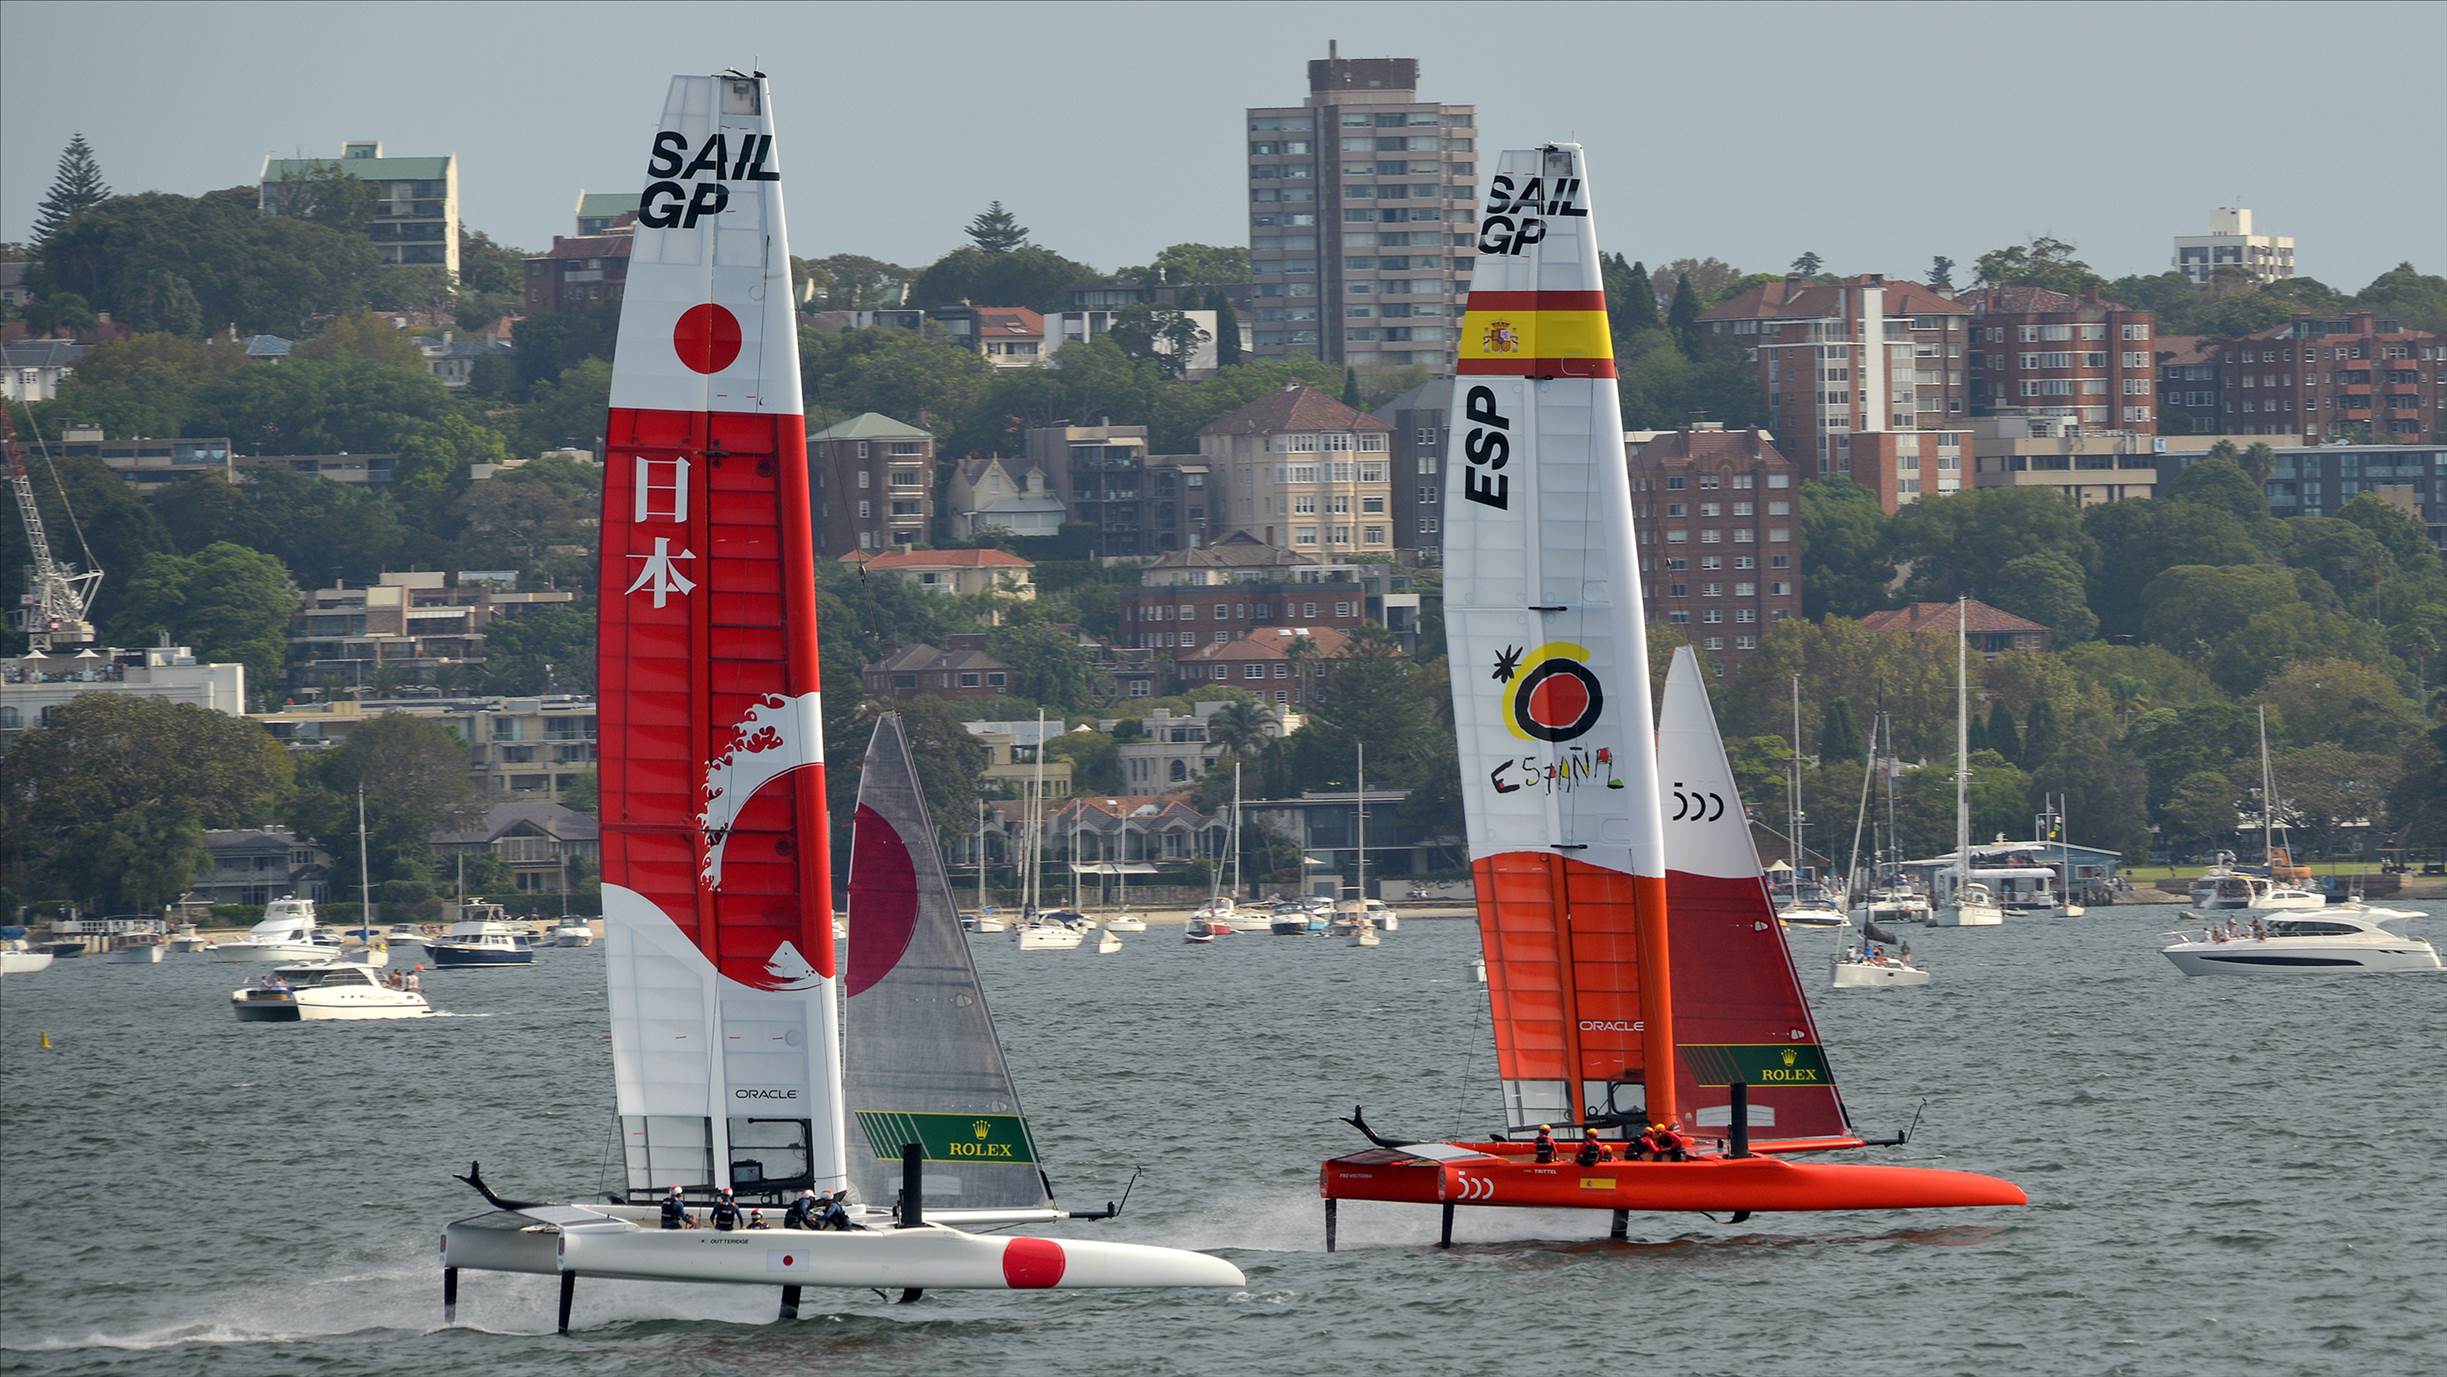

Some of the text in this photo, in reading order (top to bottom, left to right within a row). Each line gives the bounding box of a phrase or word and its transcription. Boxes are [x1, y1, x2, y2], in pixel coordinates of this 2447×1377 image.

[647, 131, 780, 181] SAIL
[638, 181, 729, 229] GP
[1486, 175, 1588, 217] SAIL
[1478, 215, 1548, 255] GP
[1465, 385, 1509, 511] ESP
[624, 456, 697, 608] 日本
[1579, 1020, 1645, 1032] ORACLE
[735, 1089, 797, 1099] ORACLE
[1762, 1069, 1817, 1081] ROLEX
[949, 1142, 1012, 1157] ROLEX
